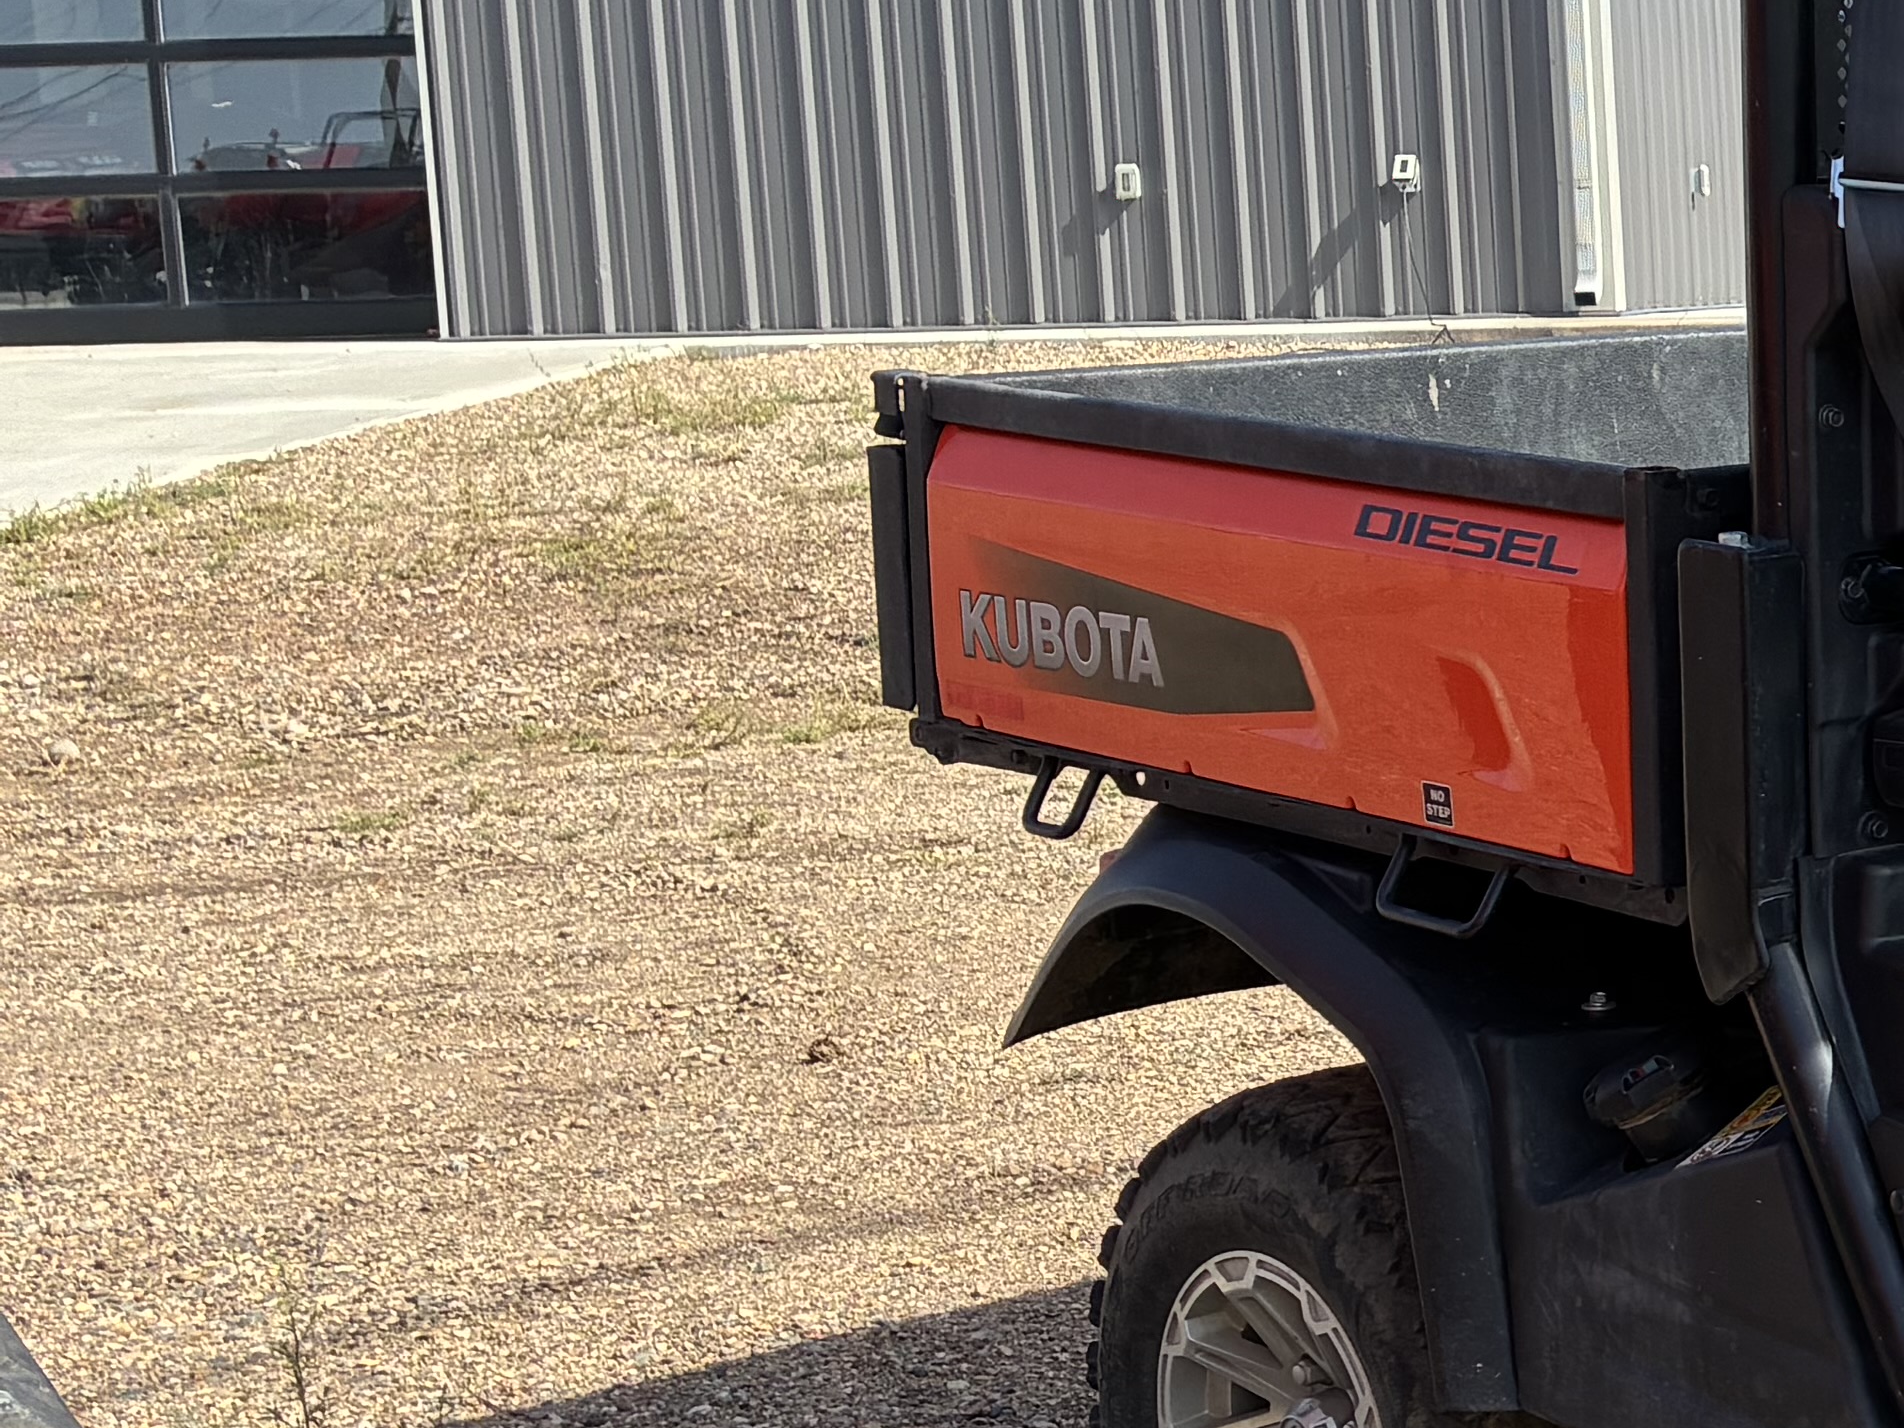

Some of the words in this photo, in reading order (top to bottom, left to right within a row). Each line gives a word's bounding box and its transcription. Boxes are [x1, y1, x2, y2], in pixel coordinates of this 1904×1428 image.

[1354, 504, 1580, 575] DIESEL
[959, 588, 1165, 688] KUBOTA
[1426, 803, 1451, 818] STEP
[1430, 789, 1445, 802] NO
